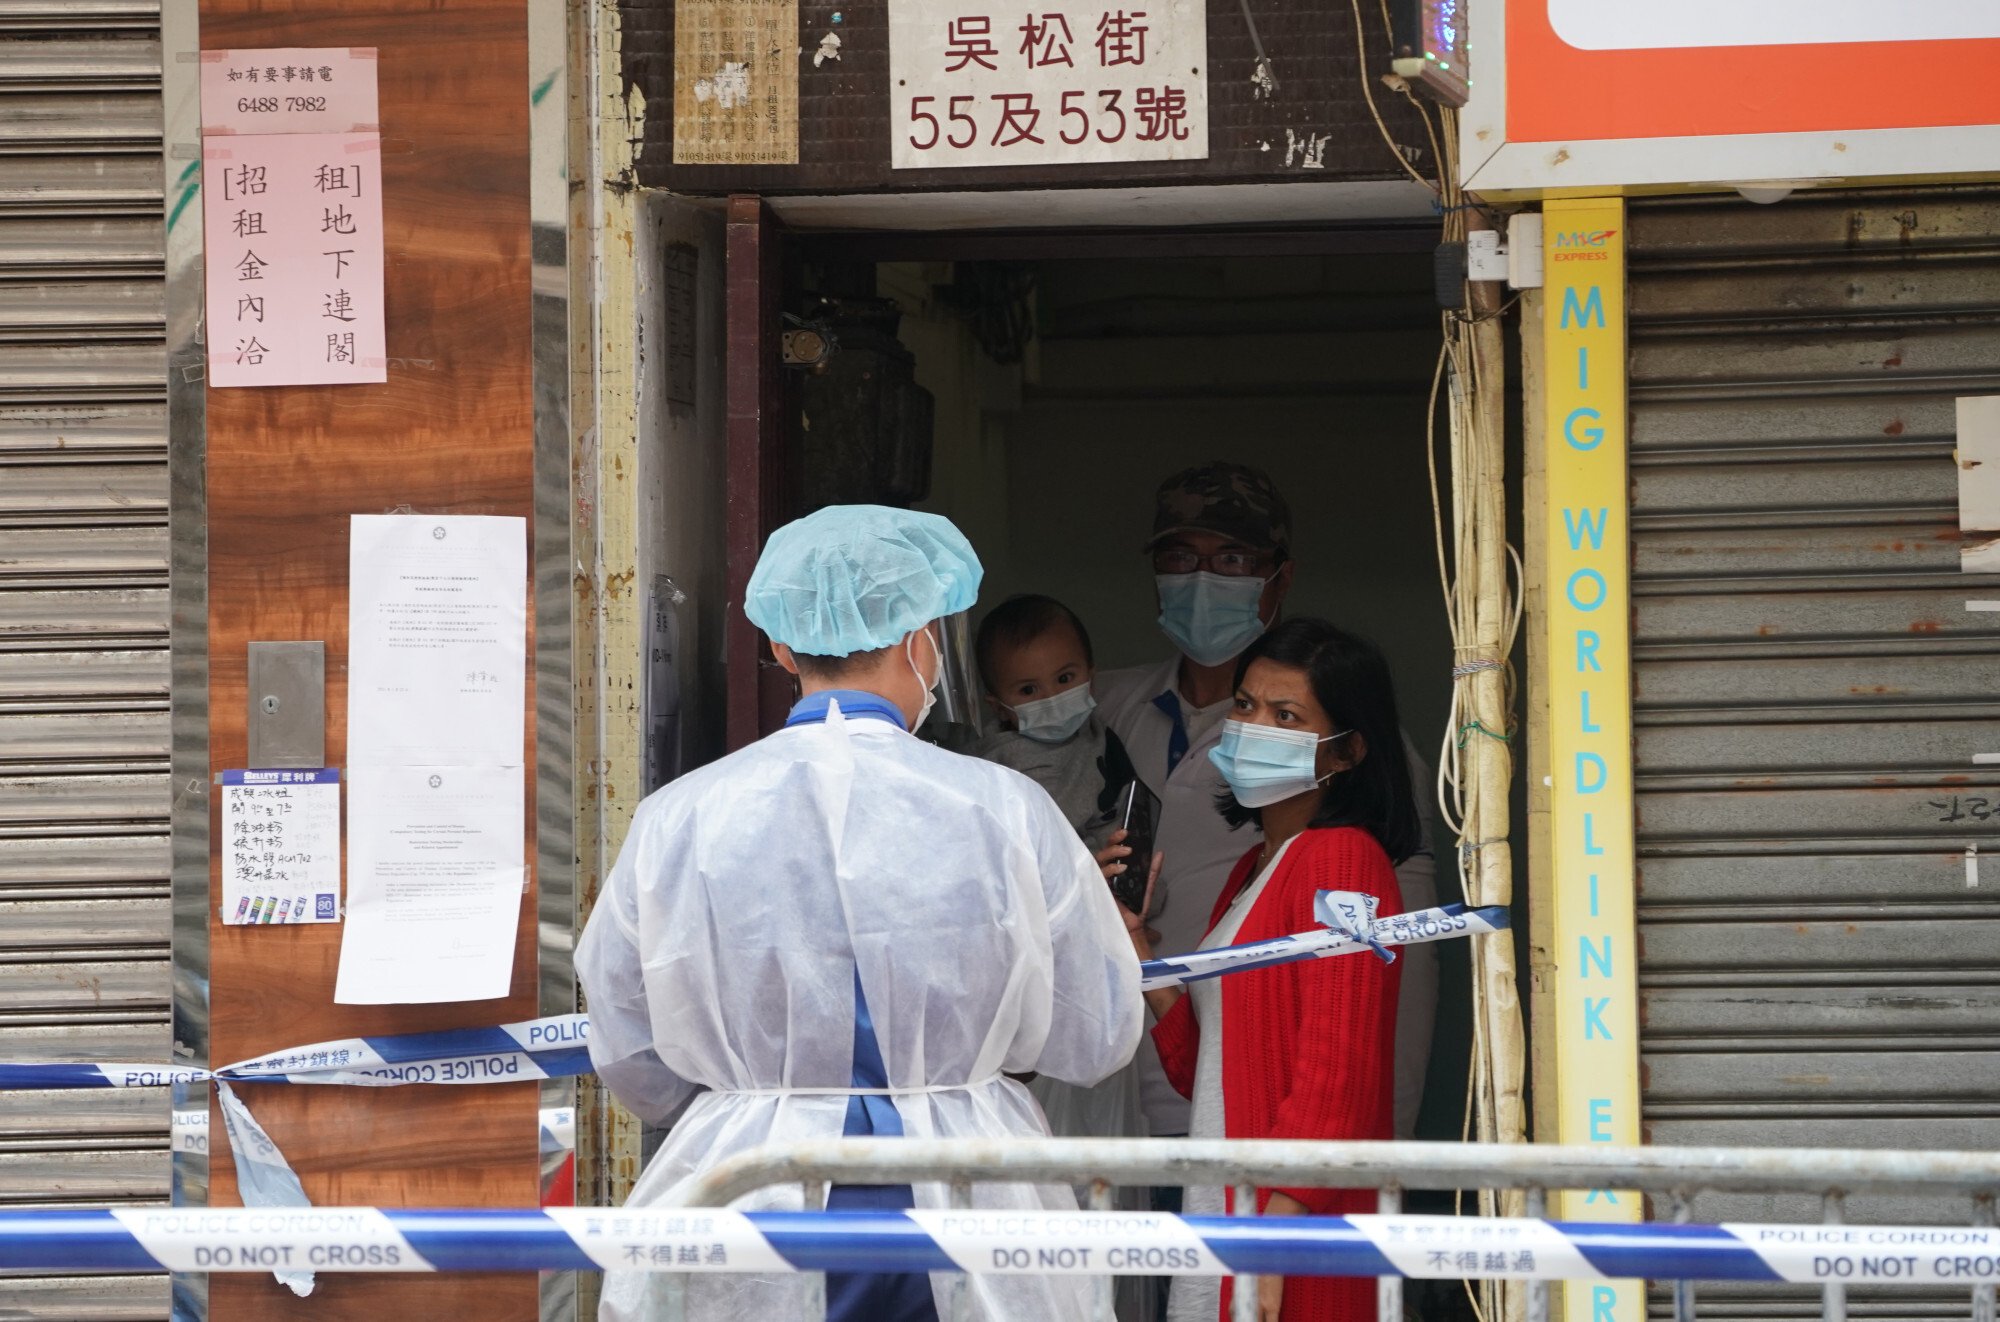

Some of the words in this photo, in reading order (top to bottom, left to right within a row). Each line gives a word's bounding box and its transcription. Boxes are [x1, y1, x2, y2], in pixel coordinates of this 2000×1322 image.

[945, 10, 1148, 73] 吳松街
[226, 66, 333, 83] 如有要事請電
[237, 97, 279, 112] 6488
[285, 96, 326, 112] 7982
[909, 85, 1189, 149] 55及53號
[1556, 230, 1607, 247] MIG
[1553, 252, 1608, 262] EXPRESS
[1560, 286, 1606, 452] MIG
[1563, 508, 1613, 1041] WORLDLINK
[317, 900, 332, 911] 80
[1393, 915, 1468, 942] CROSS
[441, 1055, 519, 1081] POLICE
[145, 1215, 239, 1234] POLICE
[943, 1218, 1038, 1236] POLICE
[1760, 1229, 1858, 1244] POLICE
[1867, 1230, 1989, 1245] CORDON
[195, 1246, 232, 1266] DO
[240, 1246, 294, 1266] NOT
[308, 1245, 401, 1266] CROSS
[622, 1243, 728, 1266] 不得越過
[993, 1248, 1031, 1269] DO
[1038, 1248, 1093, 1269] NOT
[1106, 1248, 1201, 1269] CROSS
[1427, 1250, 1535, 1273] 不得越過
[1813, 1256, 1854, 1277] DO
[1861, 1256, 1918, 1277] NOT
